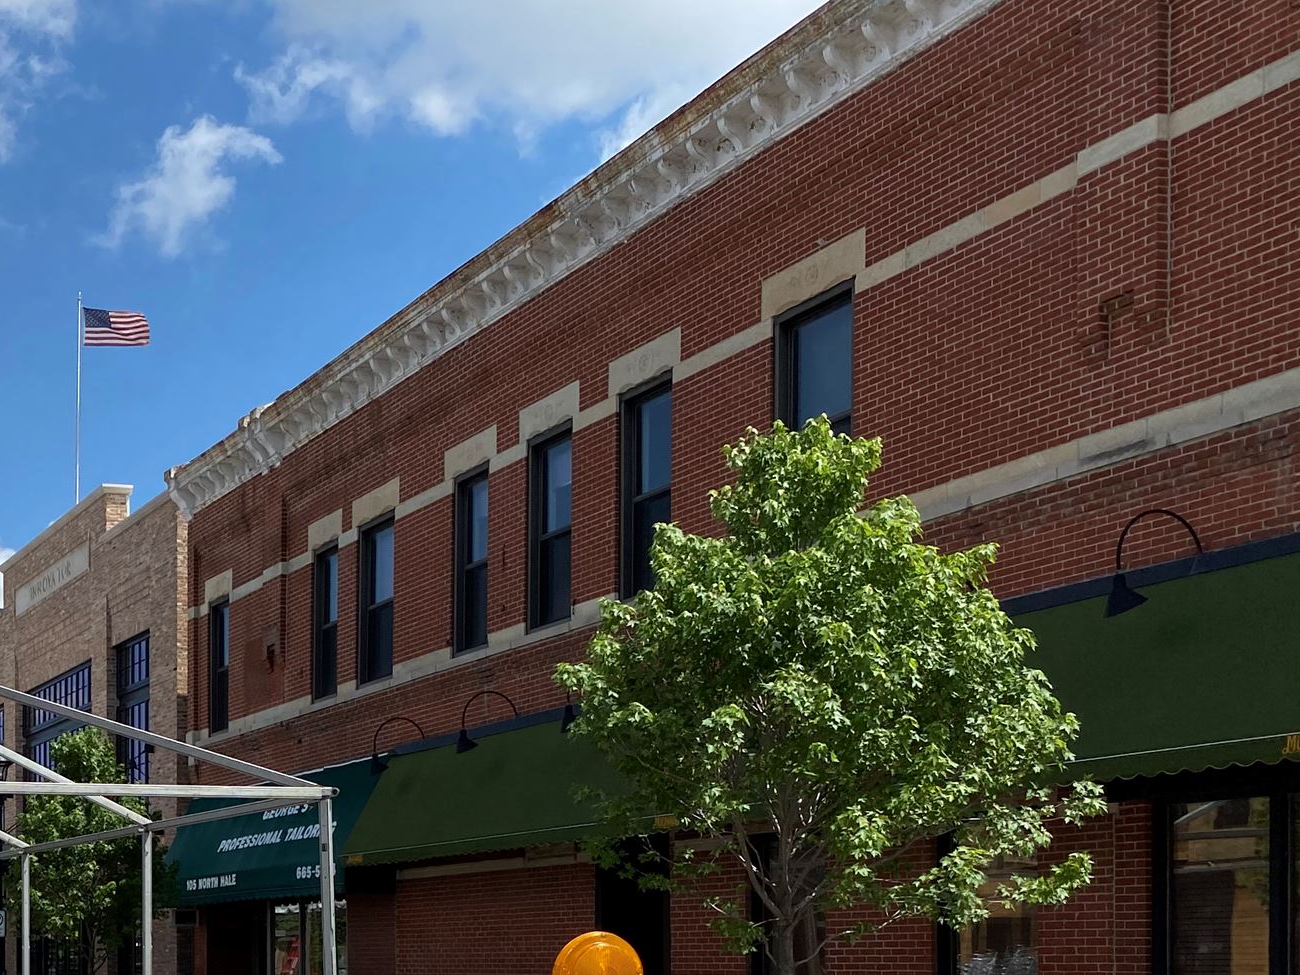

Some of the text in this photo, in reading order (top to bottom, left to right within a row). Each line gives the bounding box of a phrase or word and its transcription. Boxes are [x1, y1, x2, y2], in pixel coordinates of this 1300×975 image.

[217, 821, 337, 853] PROFESSIONAL TAILOR
[296, 863, 336, 880] 665-5
[186, 873, 237, 891] 105 NORTH HALE
